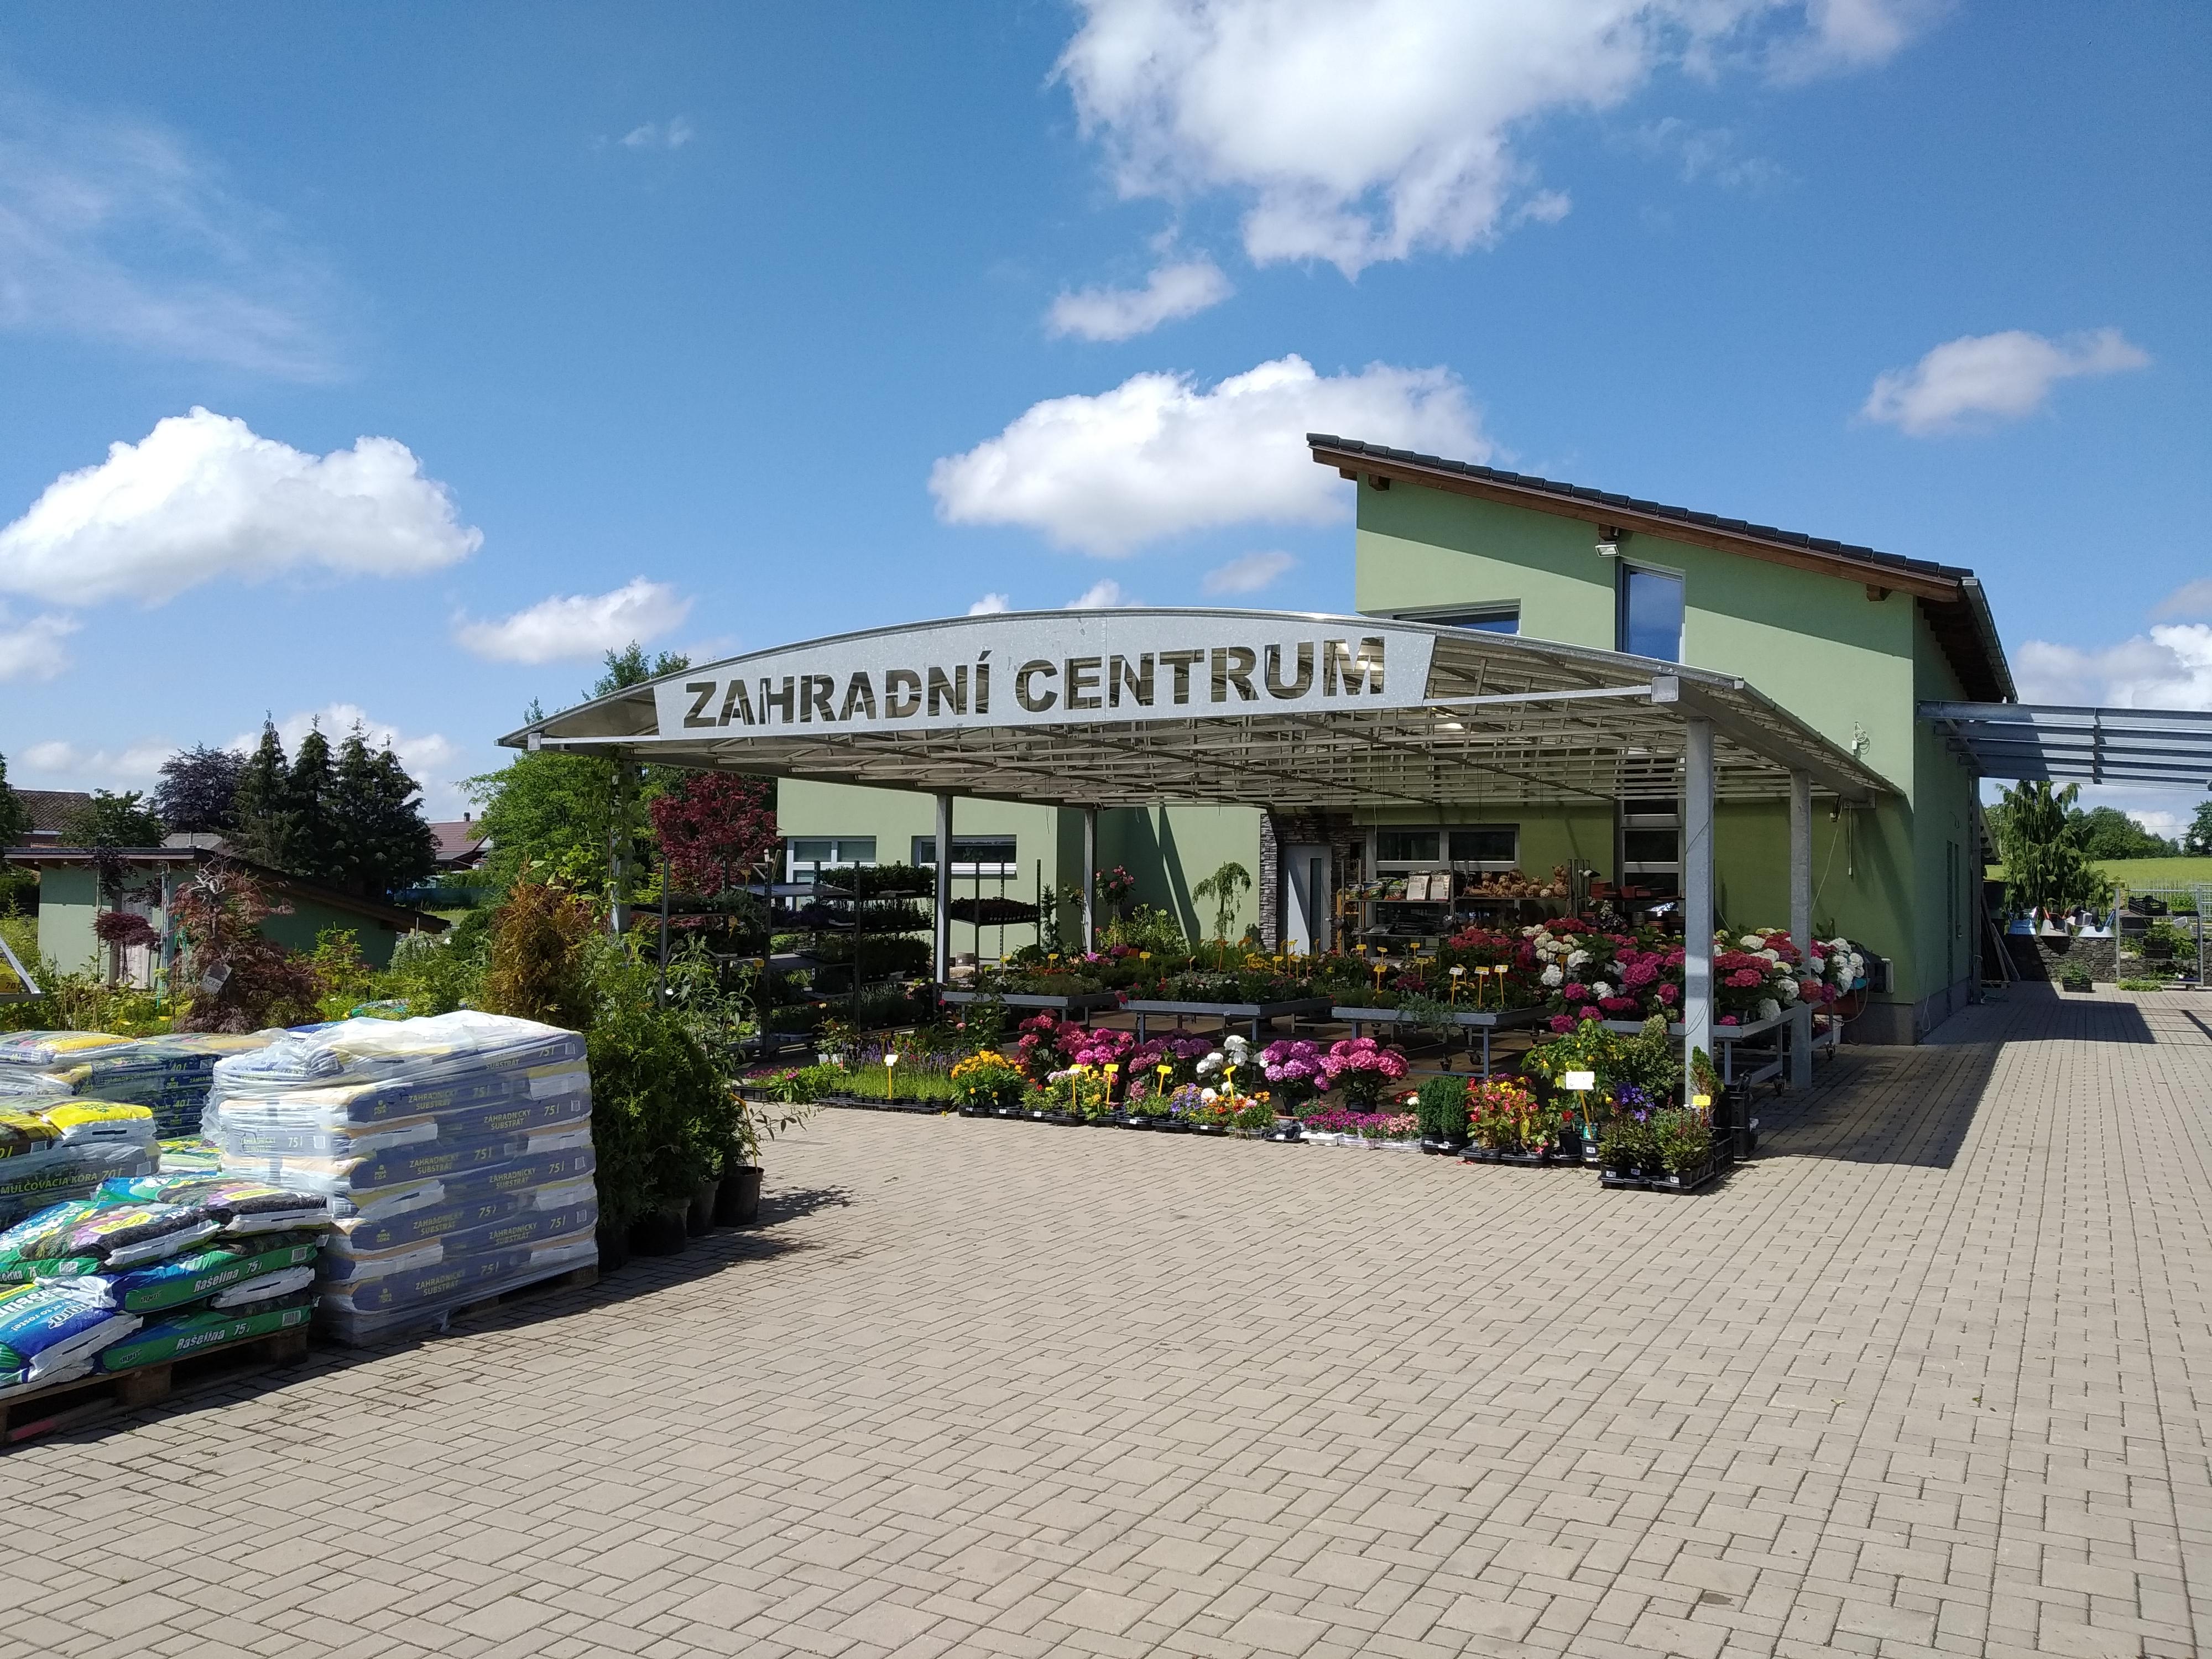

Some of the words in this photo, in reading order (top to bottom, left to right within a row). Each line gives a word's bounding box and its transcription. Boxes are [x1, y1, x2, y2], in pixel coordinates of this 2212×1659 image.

[684, 650, 992, 728] ZAHRADNÍ
[1015, 636, 1384, 712] CENTRUM
[544, 1105, 555, 1116] 75
[288, 1137, 298, 1147] 75
[474, 1149, 487, 1160] 75
[549, 1164, 560, 1174] 75
[478, 1206, 491, 1218] 75
[550, 1218, 561, 1229] 75
[480, 1264, 494, 1275] 75
[194, 1268, 239, 1293] Rašelina
[246, 1260, 258, 1274] 75
[176, 1329, 226, 1351] Rašelina
[233, 1323, 247, 1336] 75
